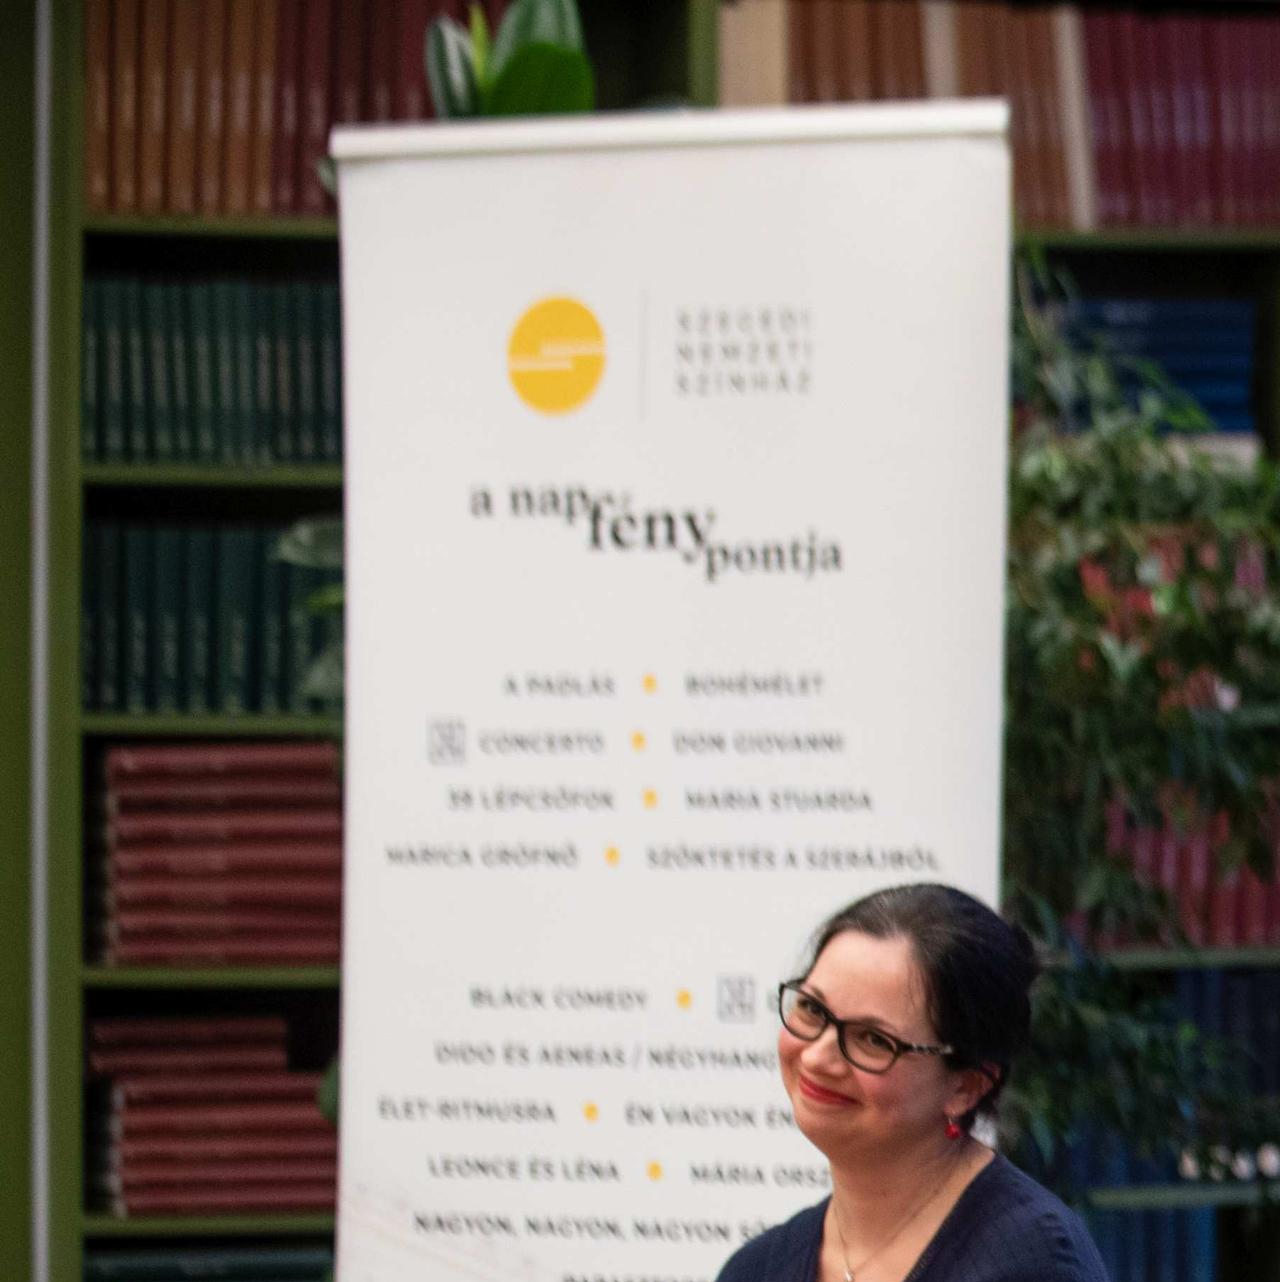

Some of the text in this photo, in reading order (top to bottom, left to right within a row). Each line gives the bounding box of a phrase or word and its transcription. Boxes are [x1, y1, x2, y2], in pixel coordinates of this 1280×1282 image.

[677, 308, 812, 338] SZEGEDI
[677, 336, 812, 368] NEMZETI
[472, 489, 494, 517] a
[470, 988, 545, 1009] BLACK
